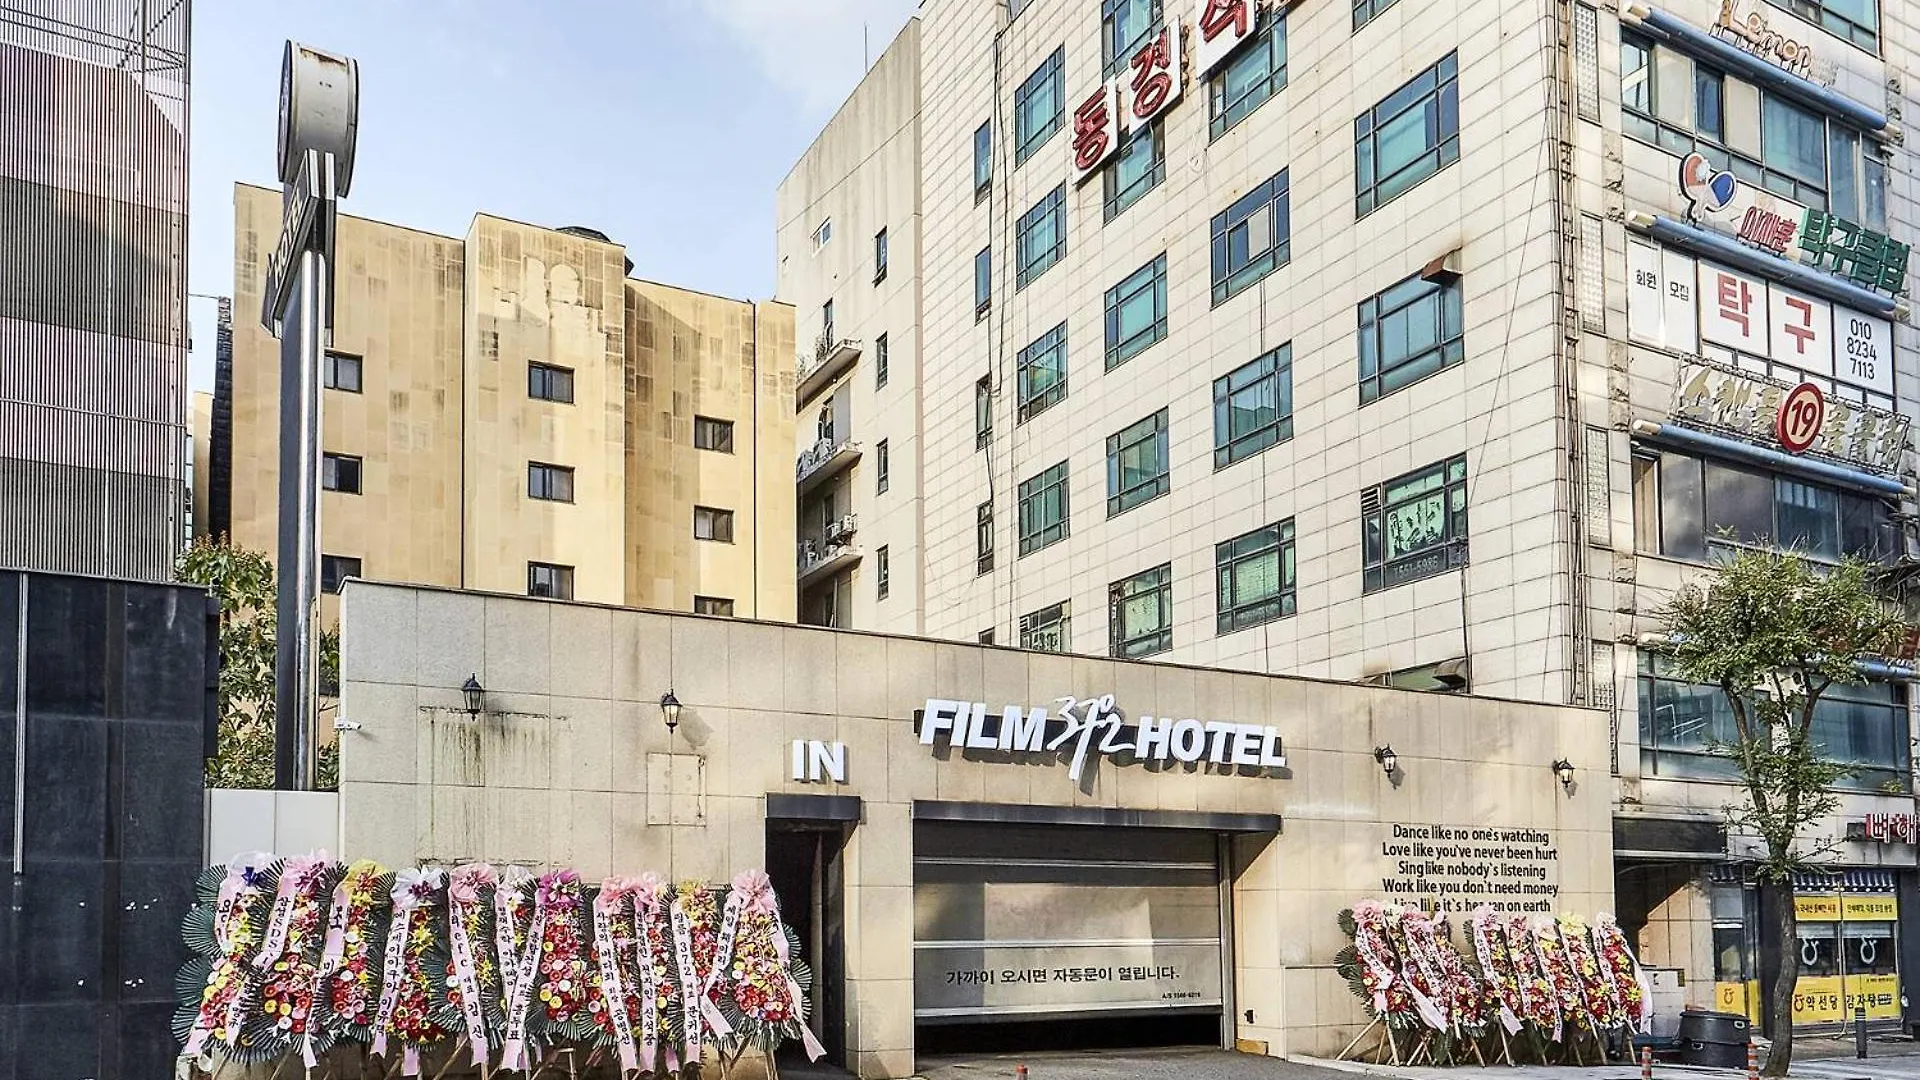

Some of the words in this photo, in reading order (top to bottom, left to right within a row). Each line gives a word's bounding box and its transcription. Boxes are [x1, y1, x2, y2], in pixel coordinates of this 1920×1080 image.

[1798, 207, 1912, 292] 탁구클럽
[1635, 269, 1657, 291] 회원
[1669, 281, 1690, 302] 모집
[1850, 318, 1872, 340] 010
[1846, 336, 1877, 362] 8234
[1850, 357, 1875, 380] 7113
[1791, 399, 1817, 437] 19
[919, 698, 1047, 752] FILM
[1134, 715, 1286, 767] HOTEL
[792, 739, 845, 782] IN
[1393, 824, 1429, 839] Dance
[1431, 826, 1451, 840] like
[1454, 829, 1469, 840] no
[1501, 829, 1549, 846] watching
[1383, 842, 1410, 856] Love
[1413, 843, 1434, 857] like
[1474, 848, 1504, 859] never
[1507, 846, 1533, 860] been
[1535, 847, 1557, 861] hurt
[1399, 861, 1424, 877] Sing
[1425, 861, 1444, 875] like
[1501, 863, 1546, 880] listening
[1383, 878, 1414, 893] Work
[1416, 879, 1437, 893] like
[1439, 882, 1460, 896] you
[1494, 880, 1521, 894] need
[1523, 884, 1559, 898] money
[1465, 899, 1505, 912] heen
[1507, 902, 1521, 912] on
[1523, 899, 1551, 912] earth
[947, 969, 994, 985] 가까이
[1000, 969, 1047, 983] 오시면
[1053, 967, 1112, 982] 자동문이
[1118, 966, 1180, 981] 열립니다.
